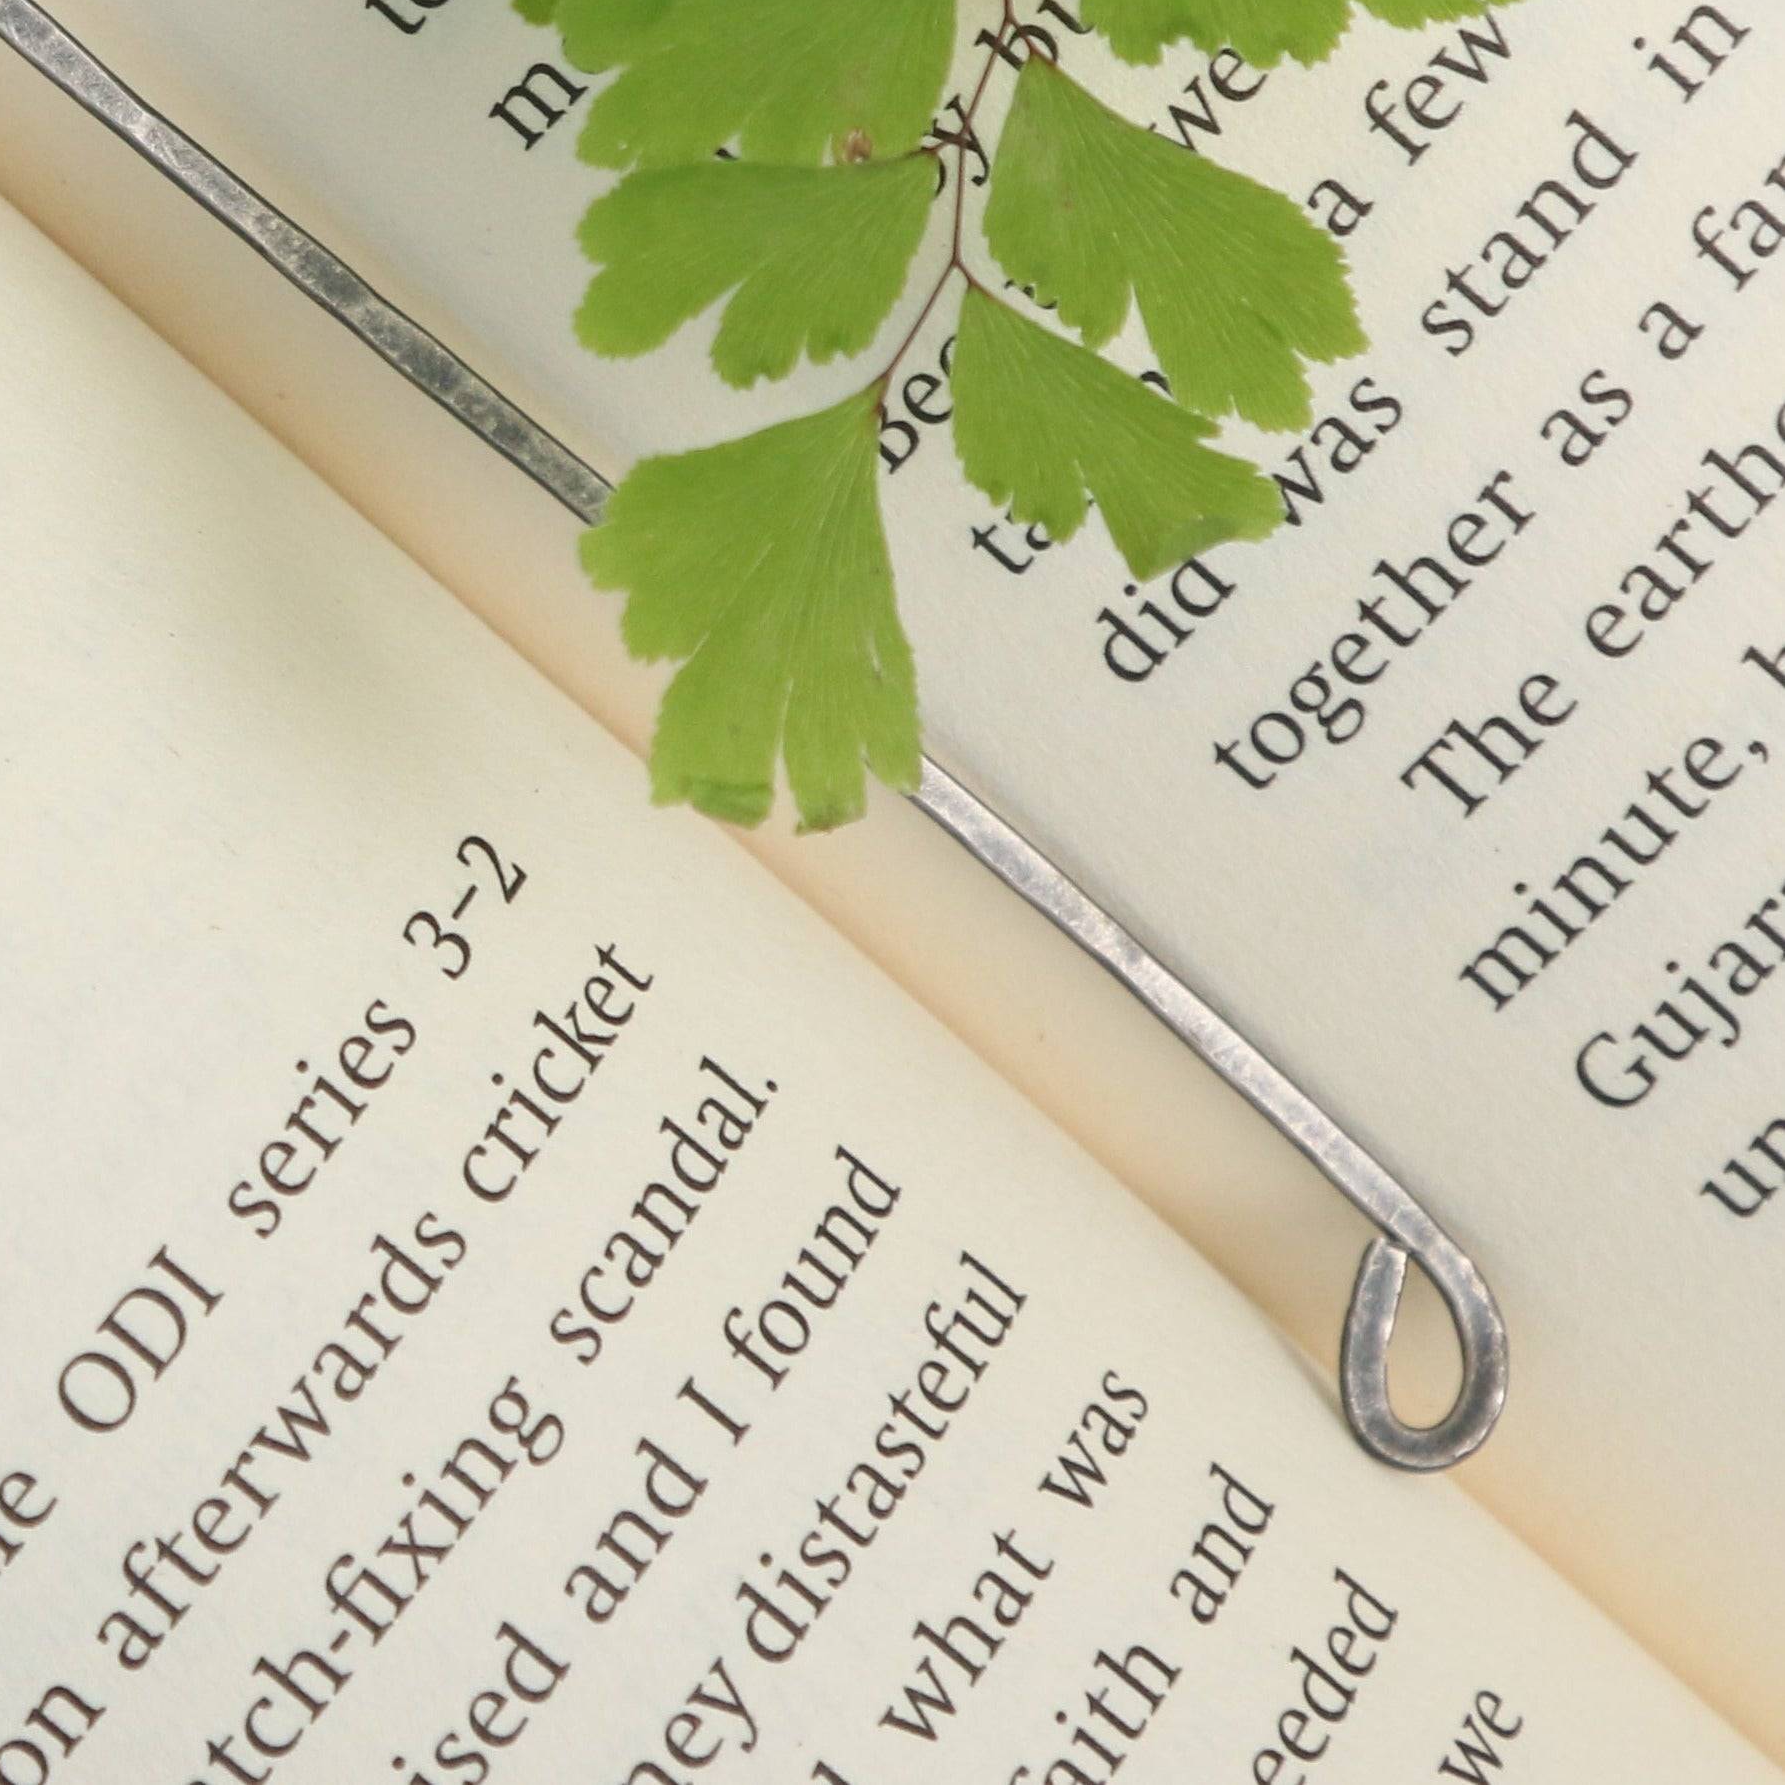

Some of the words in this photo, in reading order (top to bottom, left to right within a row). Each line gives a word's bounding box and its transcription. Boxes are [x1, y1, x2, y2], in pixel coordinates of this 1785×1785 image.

[1307, 179, 1374, 237] a
[1364, 14, 1511, 167] few
[1096, 556, 1237, 683] did
[1271, 376, 1403, 527] was
[1421, 109, 1638, 357] stand
[1633, 5, 1751, 103] in
[1213, 470, 1535, 790] together
[1540, 369, 1633, 467] as
[1638, 301, 1704, 360] a
[1399, 674, 1578, 818] The
[1459, 737, 1768, 1012] minute,
[1575, 884, 1785, 1109] Gujar
[58, 1245, 224, 1433] ODI
[228, 999, 416, 1239] series
[97, 1211, 466, 1670] afterwards
[463, 943, 654, 1202] cricket
[550, 1055, 778, 1365] scandal.
[564, 1437, 708, 1623] and
[677, 1376, 750, 1446] I
[723, 1144, 901, 1391] found
[736, 1250, 1027, 1663] distasteful
[878, 1529, 1054, 1741] what
[1037, 1370, 1148, 1508] was
[1169, 1461, 1275, 1624] and
